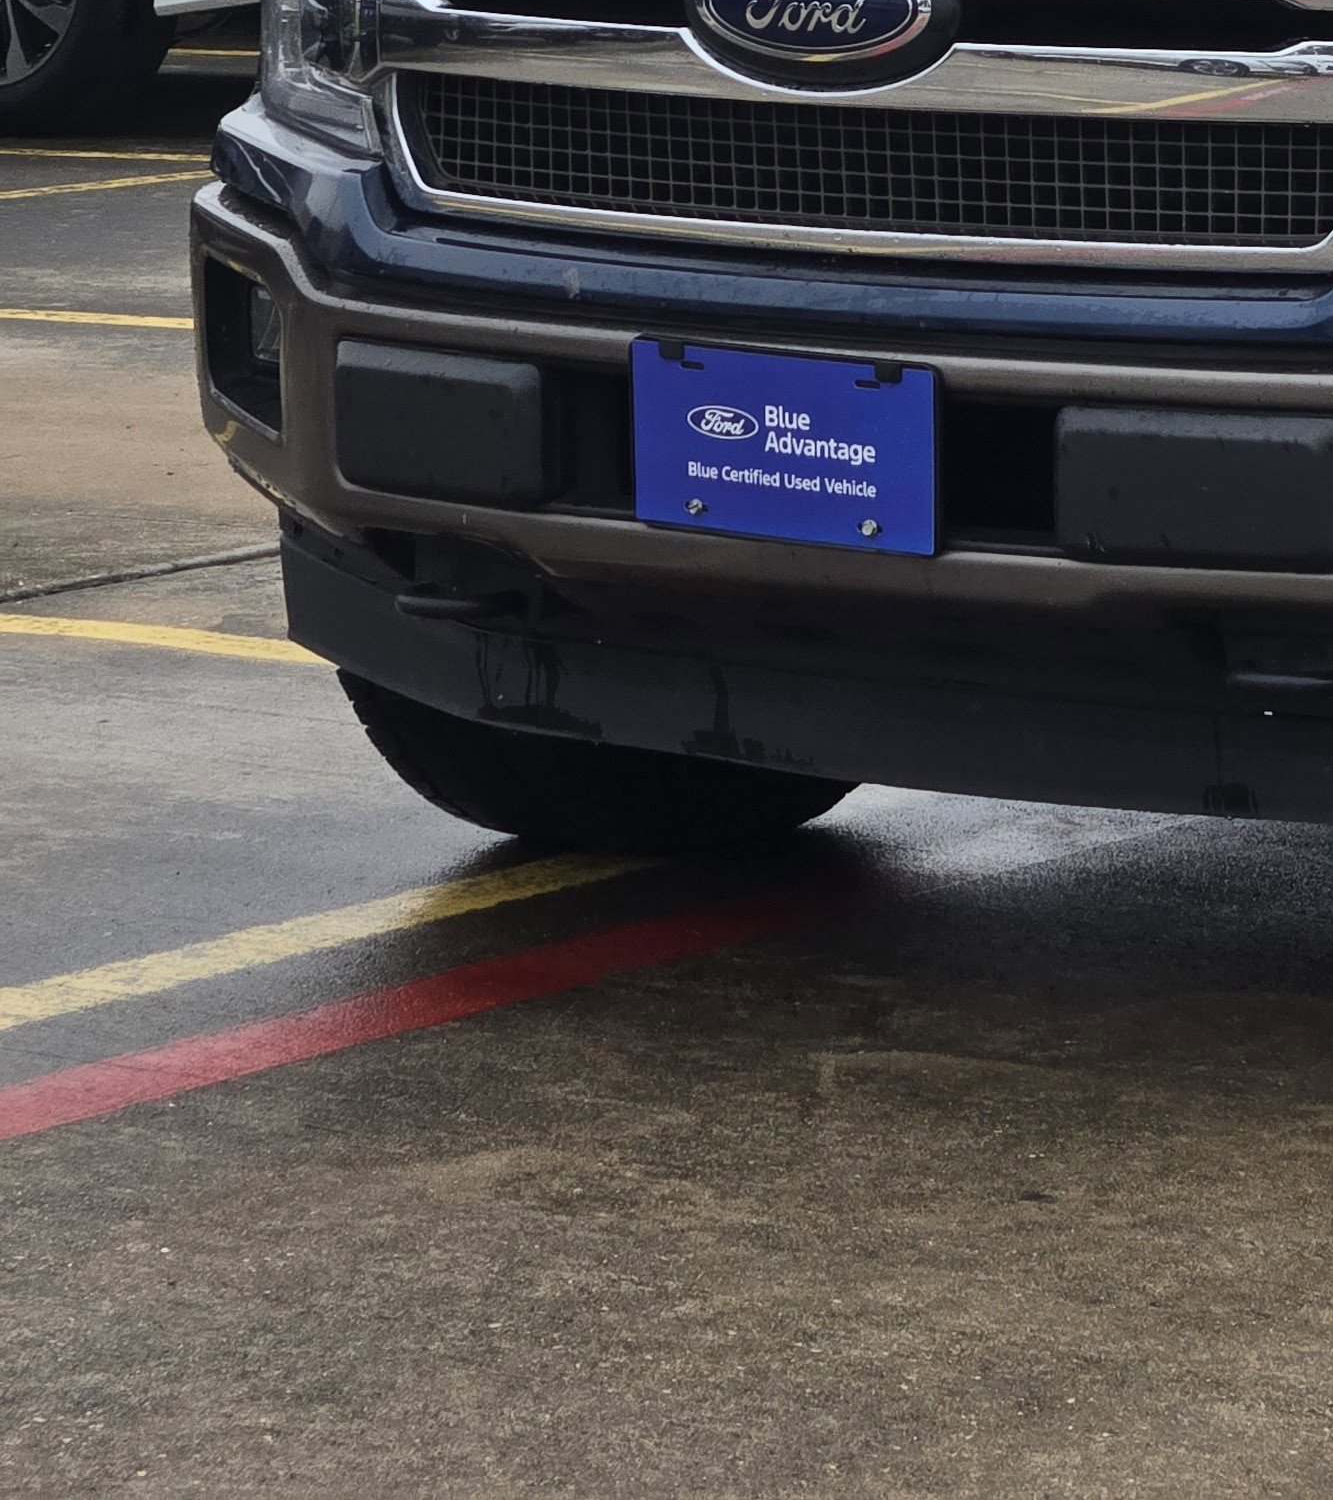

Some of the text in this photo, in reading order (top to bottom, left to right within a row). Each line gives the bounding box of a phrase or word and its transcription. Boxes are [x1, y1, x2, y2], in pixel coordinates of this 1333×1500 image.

[700, 409, 745, 435] Ford
[764, 405, 810, 430] Blue
[764, 431, 877, 466] Advantage
[687, 461, 877, 498] Blue Certified Used Vehicle
